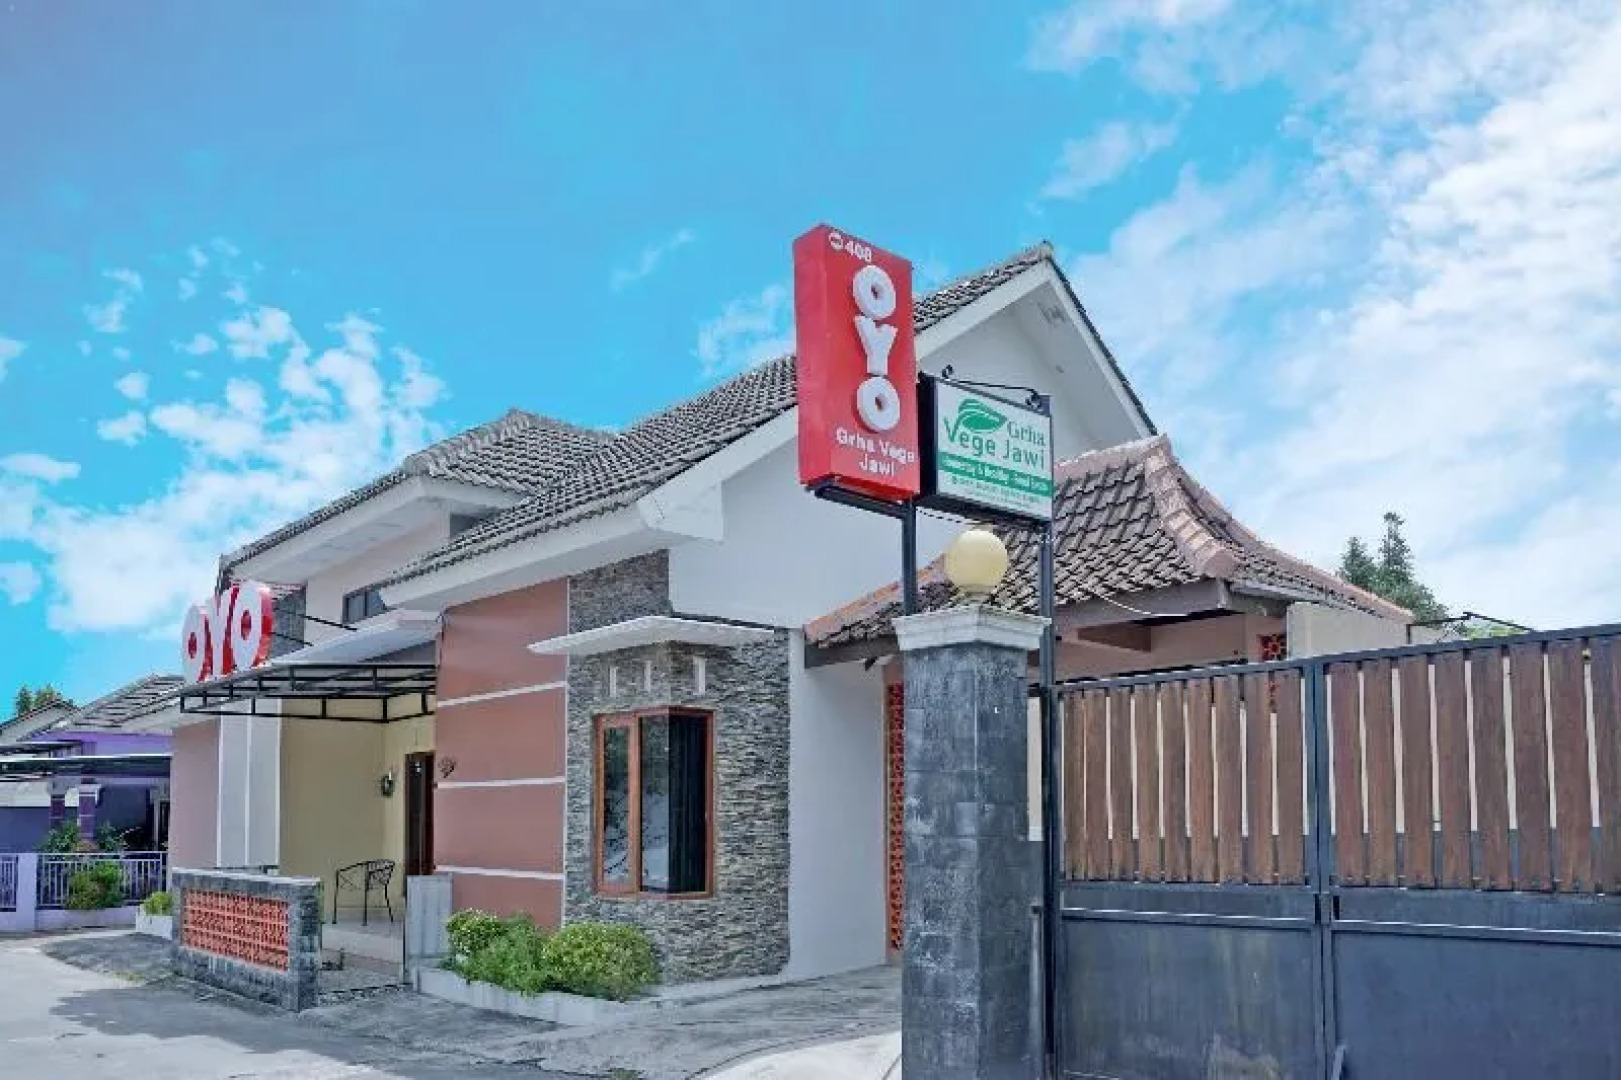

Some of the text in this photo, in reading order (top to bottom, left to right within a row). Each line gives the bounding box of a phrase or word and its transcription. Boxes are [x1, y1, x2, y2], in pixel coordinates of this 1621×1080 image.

[853, 265, 900, 433] OYO
[837, 426, 875, 453] Grha
[859, 453, 894, 477] Jawi
[943, 411, 1045, 469] Vege Jawi
[182, 580, 264, 684] OYO
